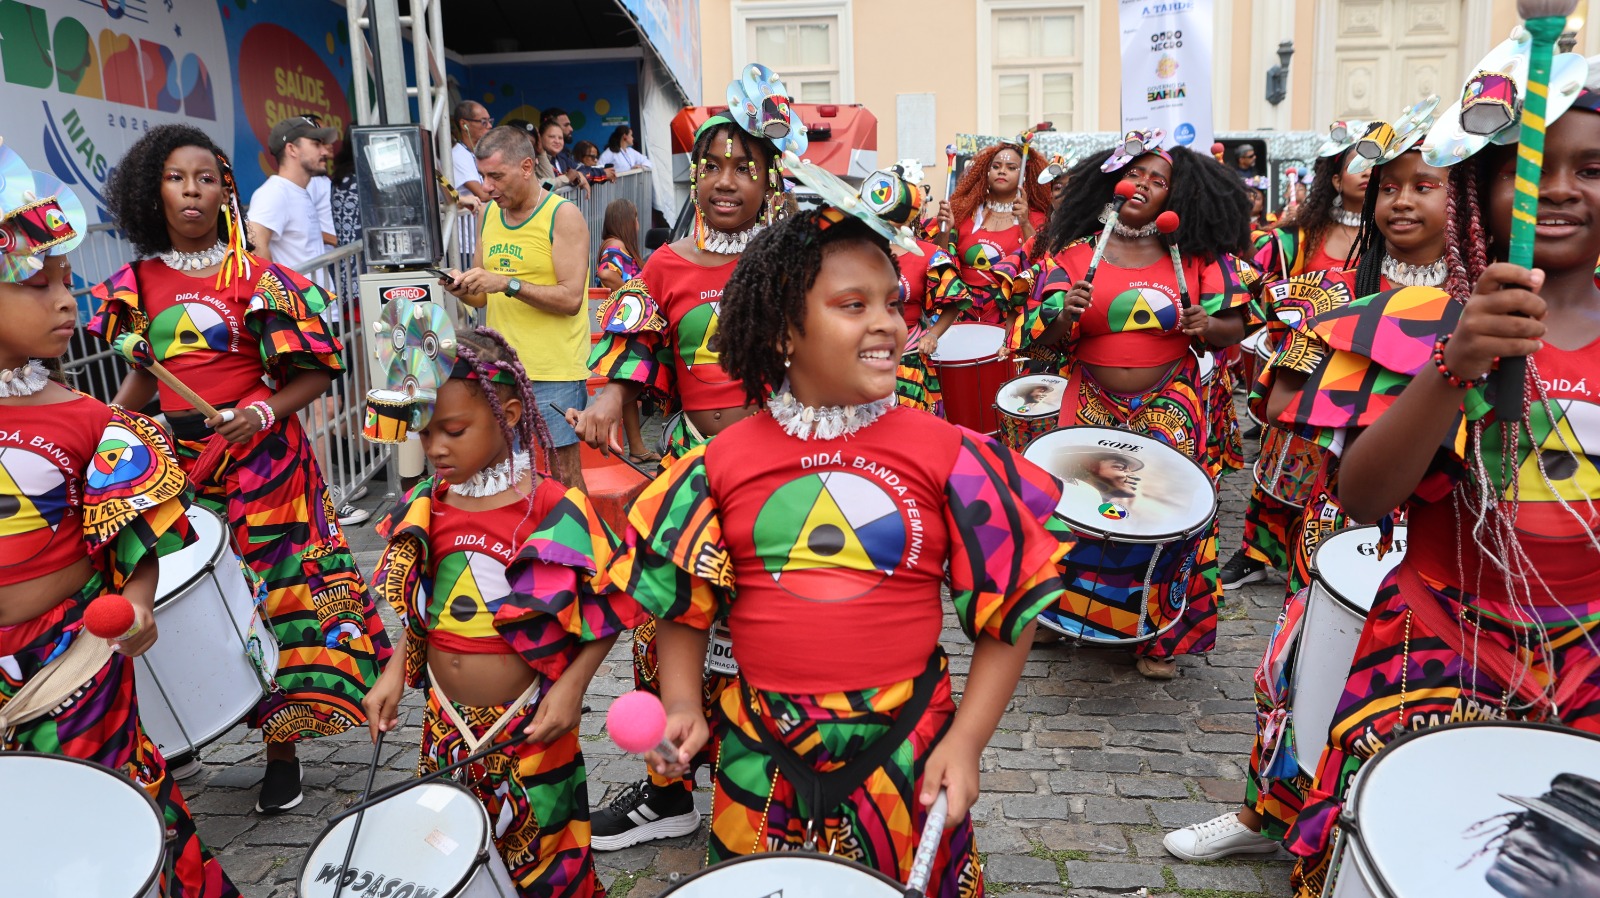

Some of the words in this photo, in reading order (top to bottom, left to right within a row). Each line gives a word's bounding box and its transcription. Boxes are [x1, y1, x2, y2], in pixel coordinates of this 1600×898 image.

[1147, 88, 1187, 102] BAHIA
[108, 113, 149, 131] 2026
[488, 243, 523, 260] BRASIL
[391, 289, 420, 299] PERIGO
[1152, 283, 1177, 298] BANDA
[202, 295, 230, 315] BANDA
[1539, 378, 1592, 396] DIDÁ,
[1163, 416, 1179, 432] FUNK
[1166, 405, 1188, 426] 2026
[1097, 439, 1143, 453] GOPE
[801, 451, 847, 469] DIDÁ,
[852, 456, 908, 497] BANDA
[454, 534, 487, 549] DIDÁ,
[388, 564, 408, 601] SAMBA
[313, 585, 351, 610] RNAVAL
[262, 705, 314, 734] CARNAVAL
[329, 712, 356, 732] 202
[277, 719, 313, 739] ENCONTRO
